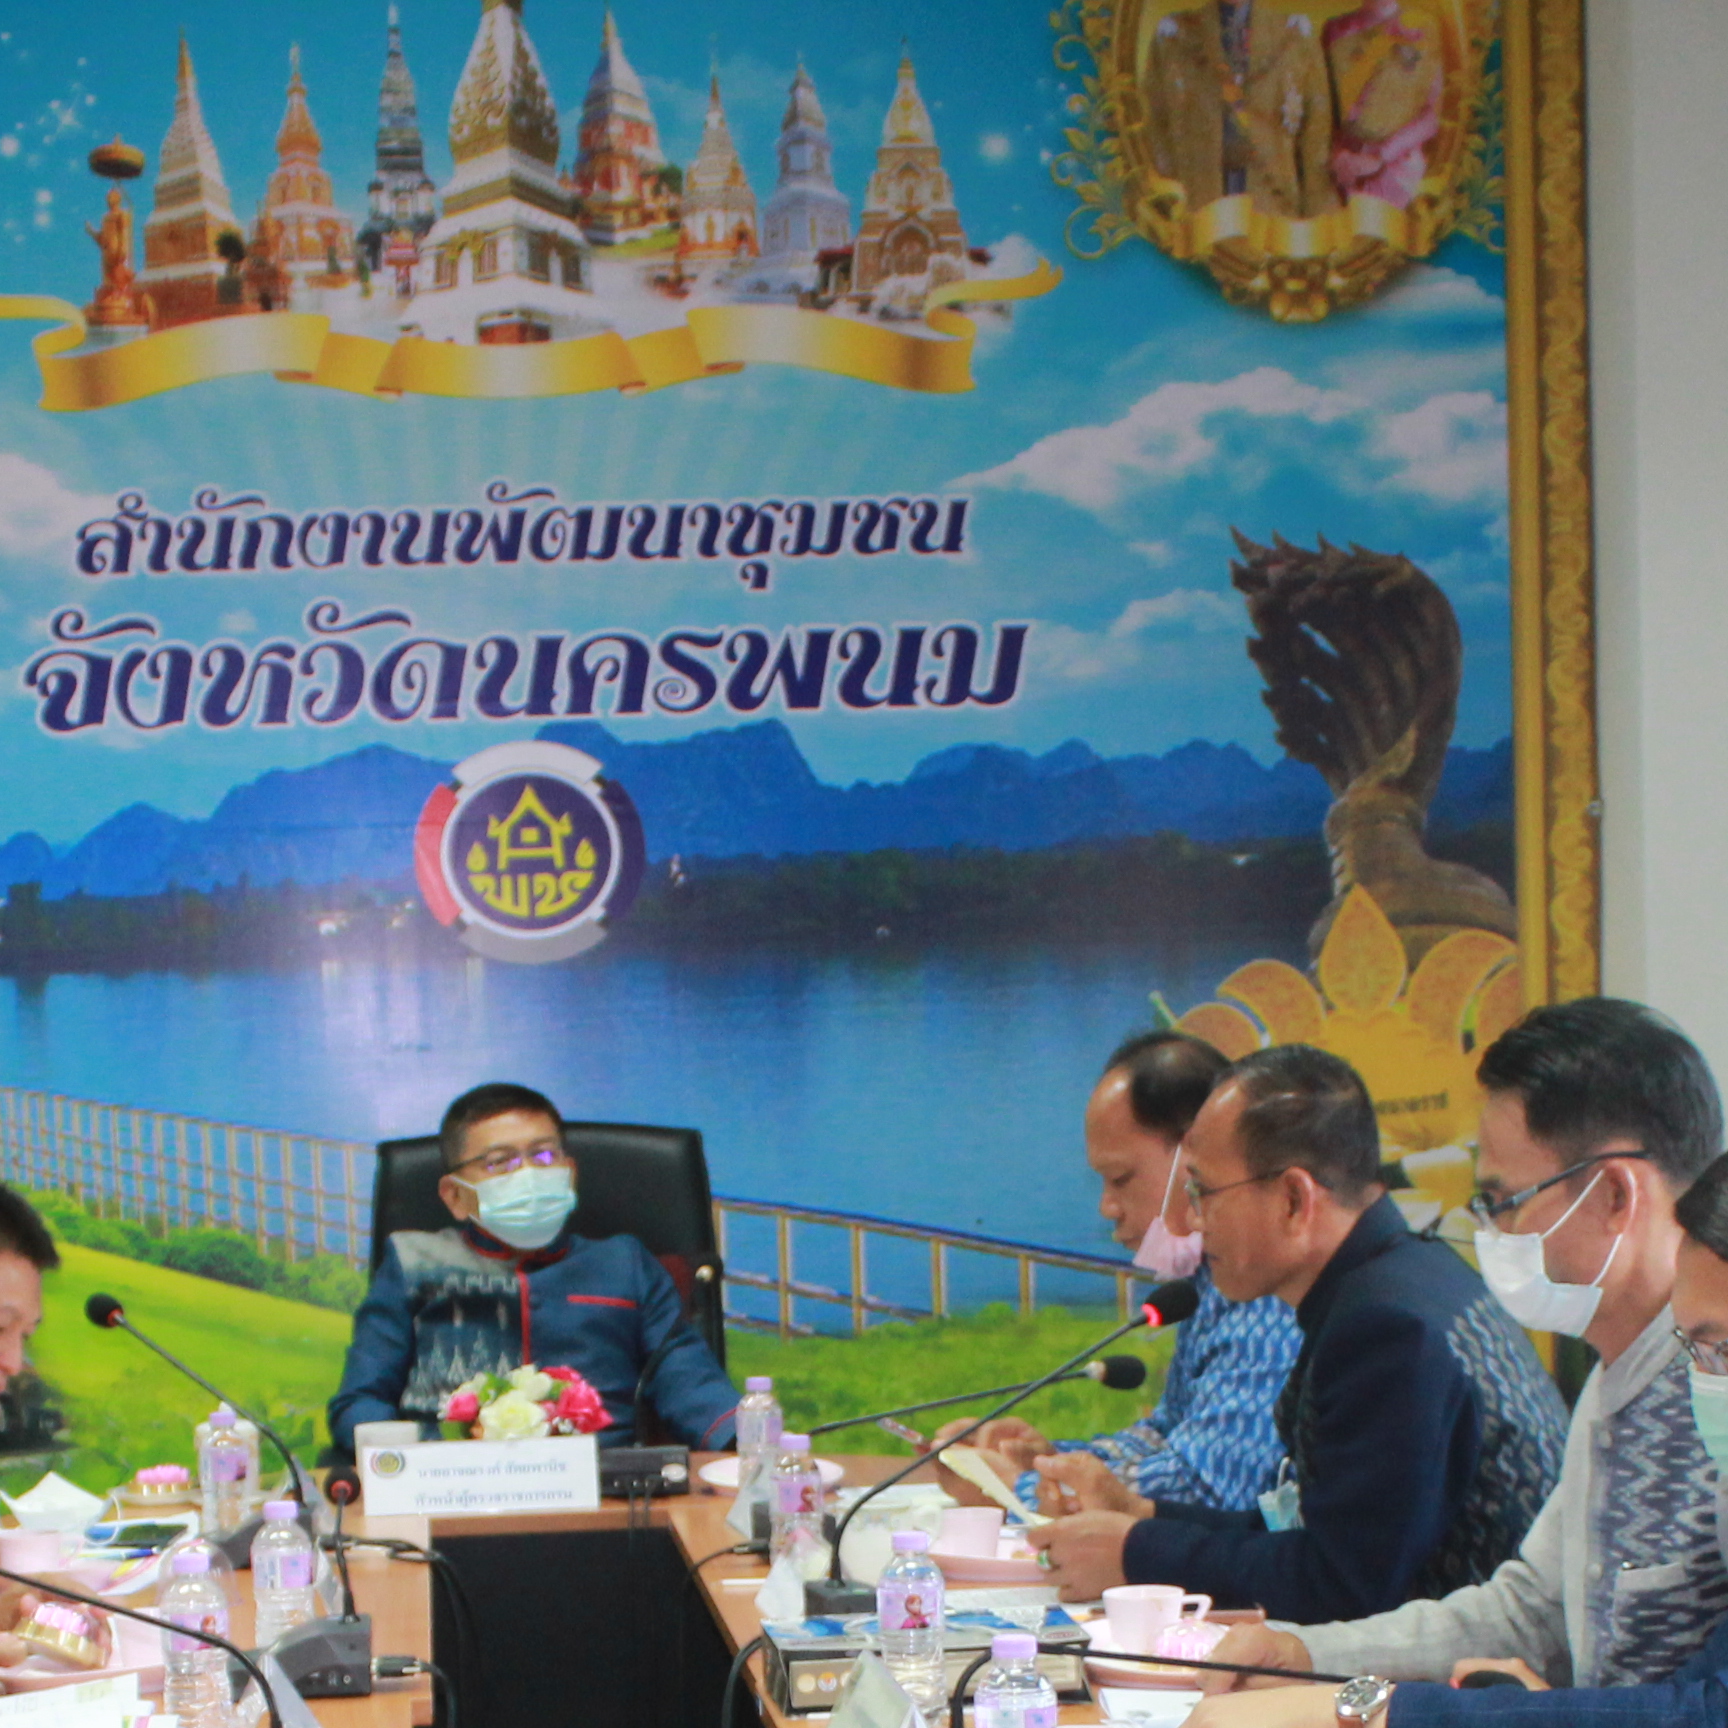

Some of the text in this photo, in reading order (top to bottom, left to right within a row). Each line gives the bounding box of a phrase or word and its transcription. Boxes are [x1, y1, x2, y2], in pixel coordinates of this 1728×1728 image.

[72, 481, 969, 591] สำนักงานพัฒนาชุมชน
[23, 601, 1030, 735] จังหวัดนครพนม
